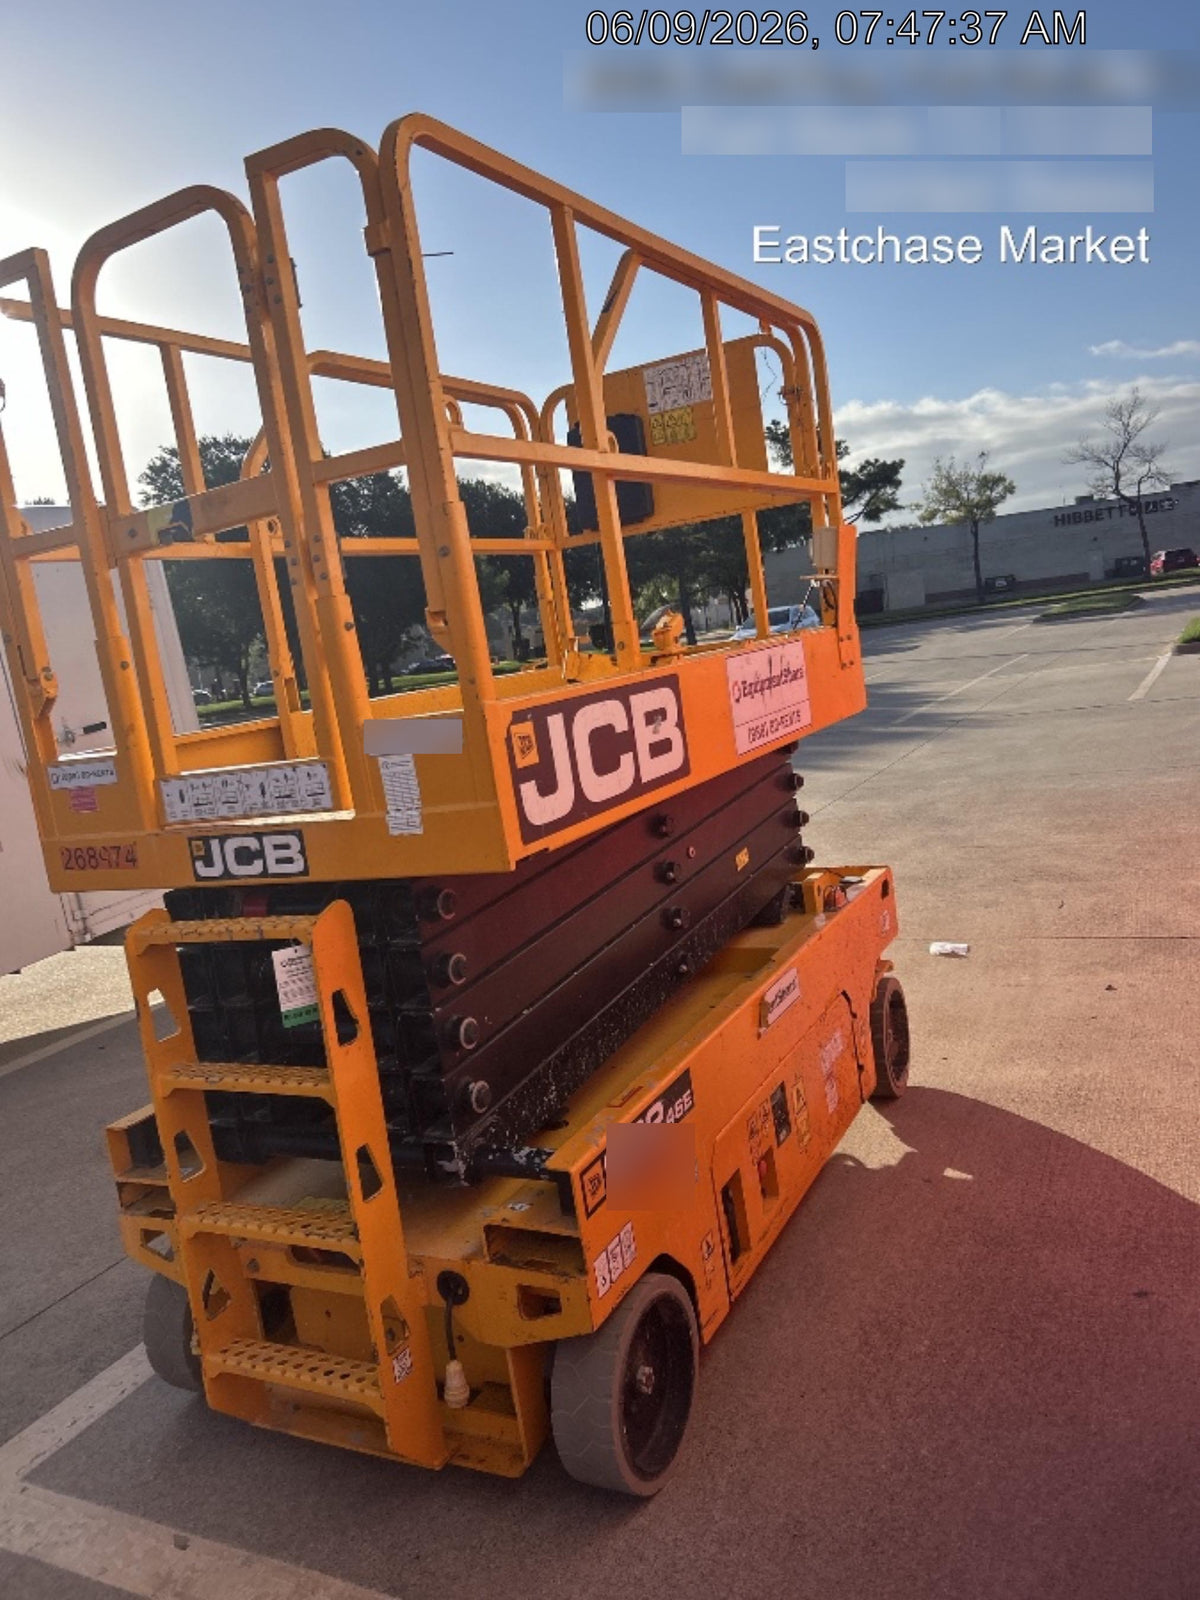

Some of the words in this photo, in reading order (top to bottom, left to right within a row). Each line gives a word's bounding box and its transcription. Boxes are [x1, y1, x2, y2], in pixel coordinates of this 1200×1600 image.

[1053, 504, 1127, 528] HIBBETT
[519, 686, 685, 827] JCB
[194, 834, 305, 877] JCB
